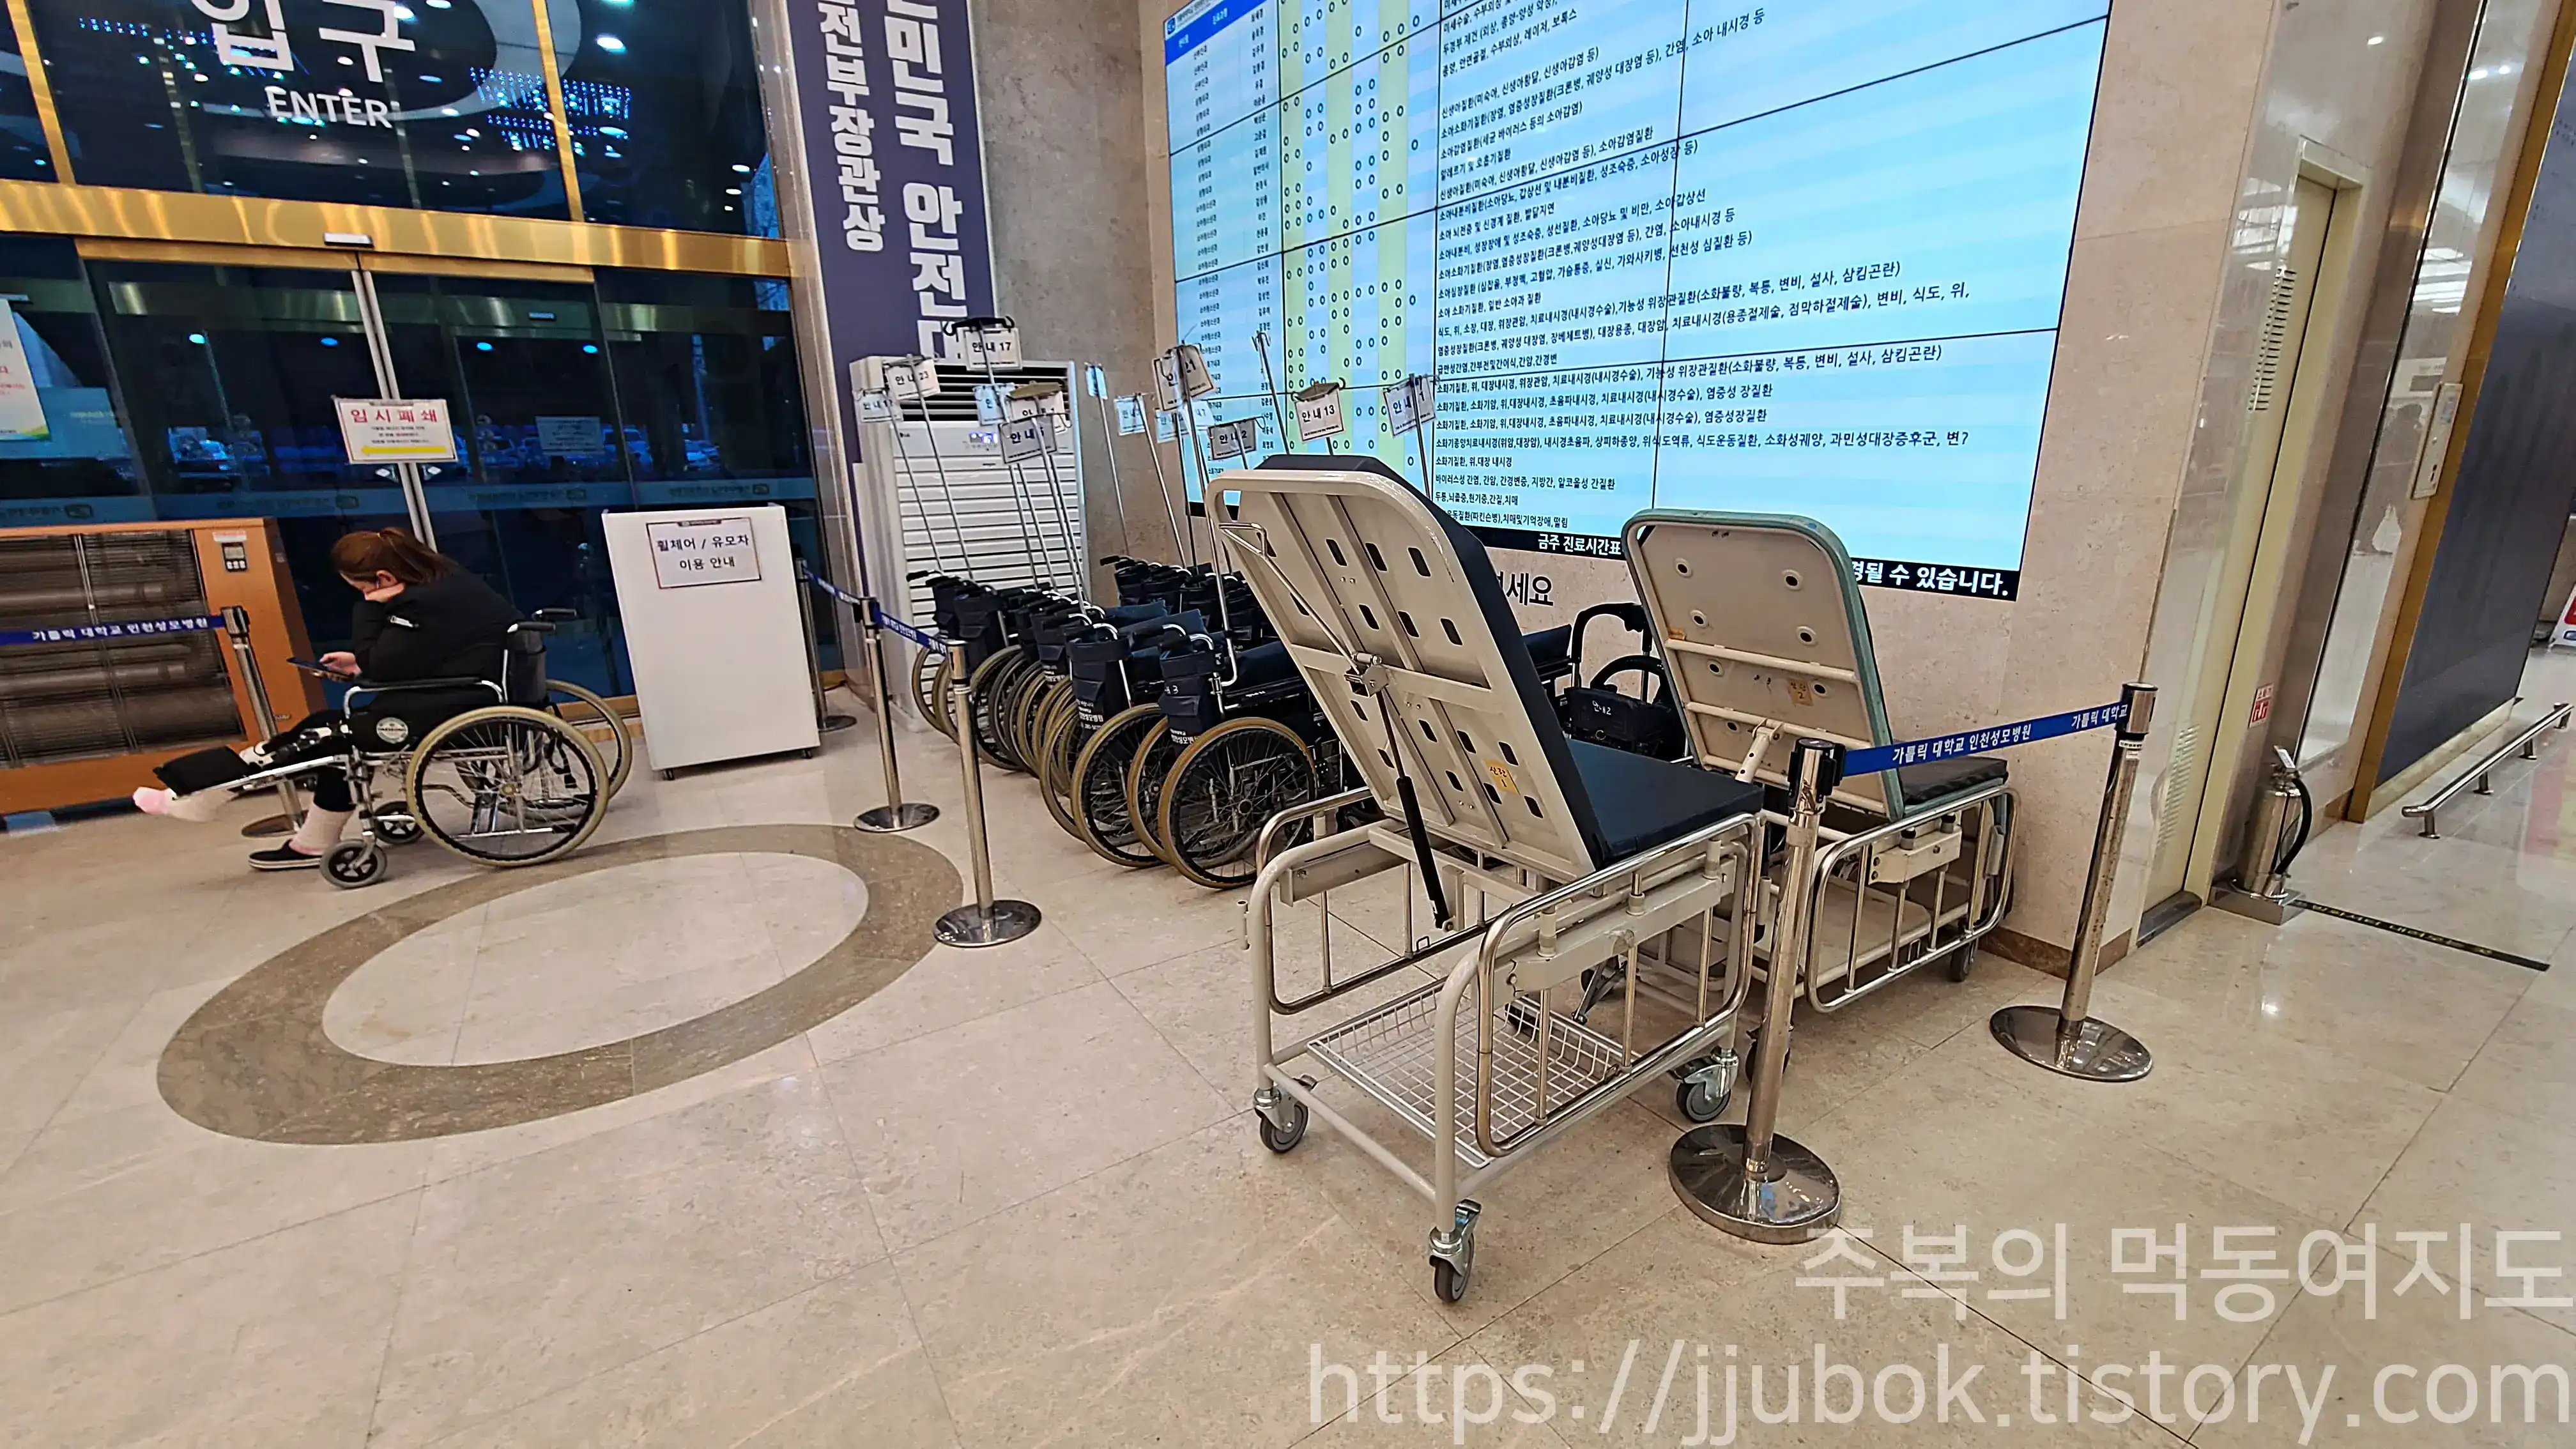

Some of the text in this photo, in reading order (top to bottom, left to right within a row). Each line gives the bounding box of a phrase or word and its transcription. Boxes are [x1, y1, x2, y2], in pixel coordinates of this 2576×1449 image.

[265, 86, 392, 130] ENTER
[818, 0, 886, 252] 전부장관상
[1498, 315, 1528, 330] 위장관암,
[1749, 279, 1774, 295] 복통,
[1779, 275, 1804, 291] 변비,
[1810, 270, 1837, 288] 설사,
[1842, 260, 1900, 282] 삼킴곤란)
[1000, 342, 1012, 351] 17
[1519, 375, 1550, 388] 위장관암,
[1783, 355, 1809, 370] 복통,
[1814, 353, 1841, 368] 변비,
[1847, 349, 1875, 366] 설사,
[1881, 344, 1941, 363] 삼킴곤란)
[1436, 401, 1469, 412] 소화기질환,
[1470, 399, 1498, 410] 소화기암,
[1500, 396, 1547, 410] 위,대장내시경,
[1549, 393, 1598, 406] 초음파내시경,
[1706, 385, 1736, 399] 염증성
[1740, 383, 1773, 398] 장질환
[1301, 404, 1335, 423] 안내 13
[1436, 419, 1468, 430] 소화기질환,
[1469, 418, 1498, 429] 소화기암,
[1499, 416, 1546, 429] 위,대장내시경,
[1548, 415, 1597, 427] 초음파내시경,
[1705, 408, 1767, 423] 염증성장질환
[1010, 429, 1036, 445] 안내
[1544, 436, 1592, 448] 내시경초음파,
[1595, 435, 1639, 448] 상피하종양,
[1696, 433, 1761, 447] 식도운동질환,
[1764, 433, 1825, 447] 소화성궤양,
[1829, 431, 1940, 447] 과민성대장증후군,
[1947, 431, 1968, 445] 변?
[1436, 456, 1512, 467] 소화기질환, 위.대장 내시경
[1436, 474, 1615, 490] 바이러스성 간염, 간암, 간경변증, 지방간, 알코올성 간질환
[657, 538, 696, 553] 휠체어
[712, 533, 749, 549] 유모차
[1538, 533, 1560, 551] 금주
[679, 556, 735, 571] 이용 안내
[1851, 560, 2009, 596] 경될 수 있습니다.
[1498, 571, 1554, 607] 세요
[81, 625, 123, 638] 대학교
[1891, 702, 2128, 765] 가톨릭 대학교 인천성모병원 가톨릭 대학교
